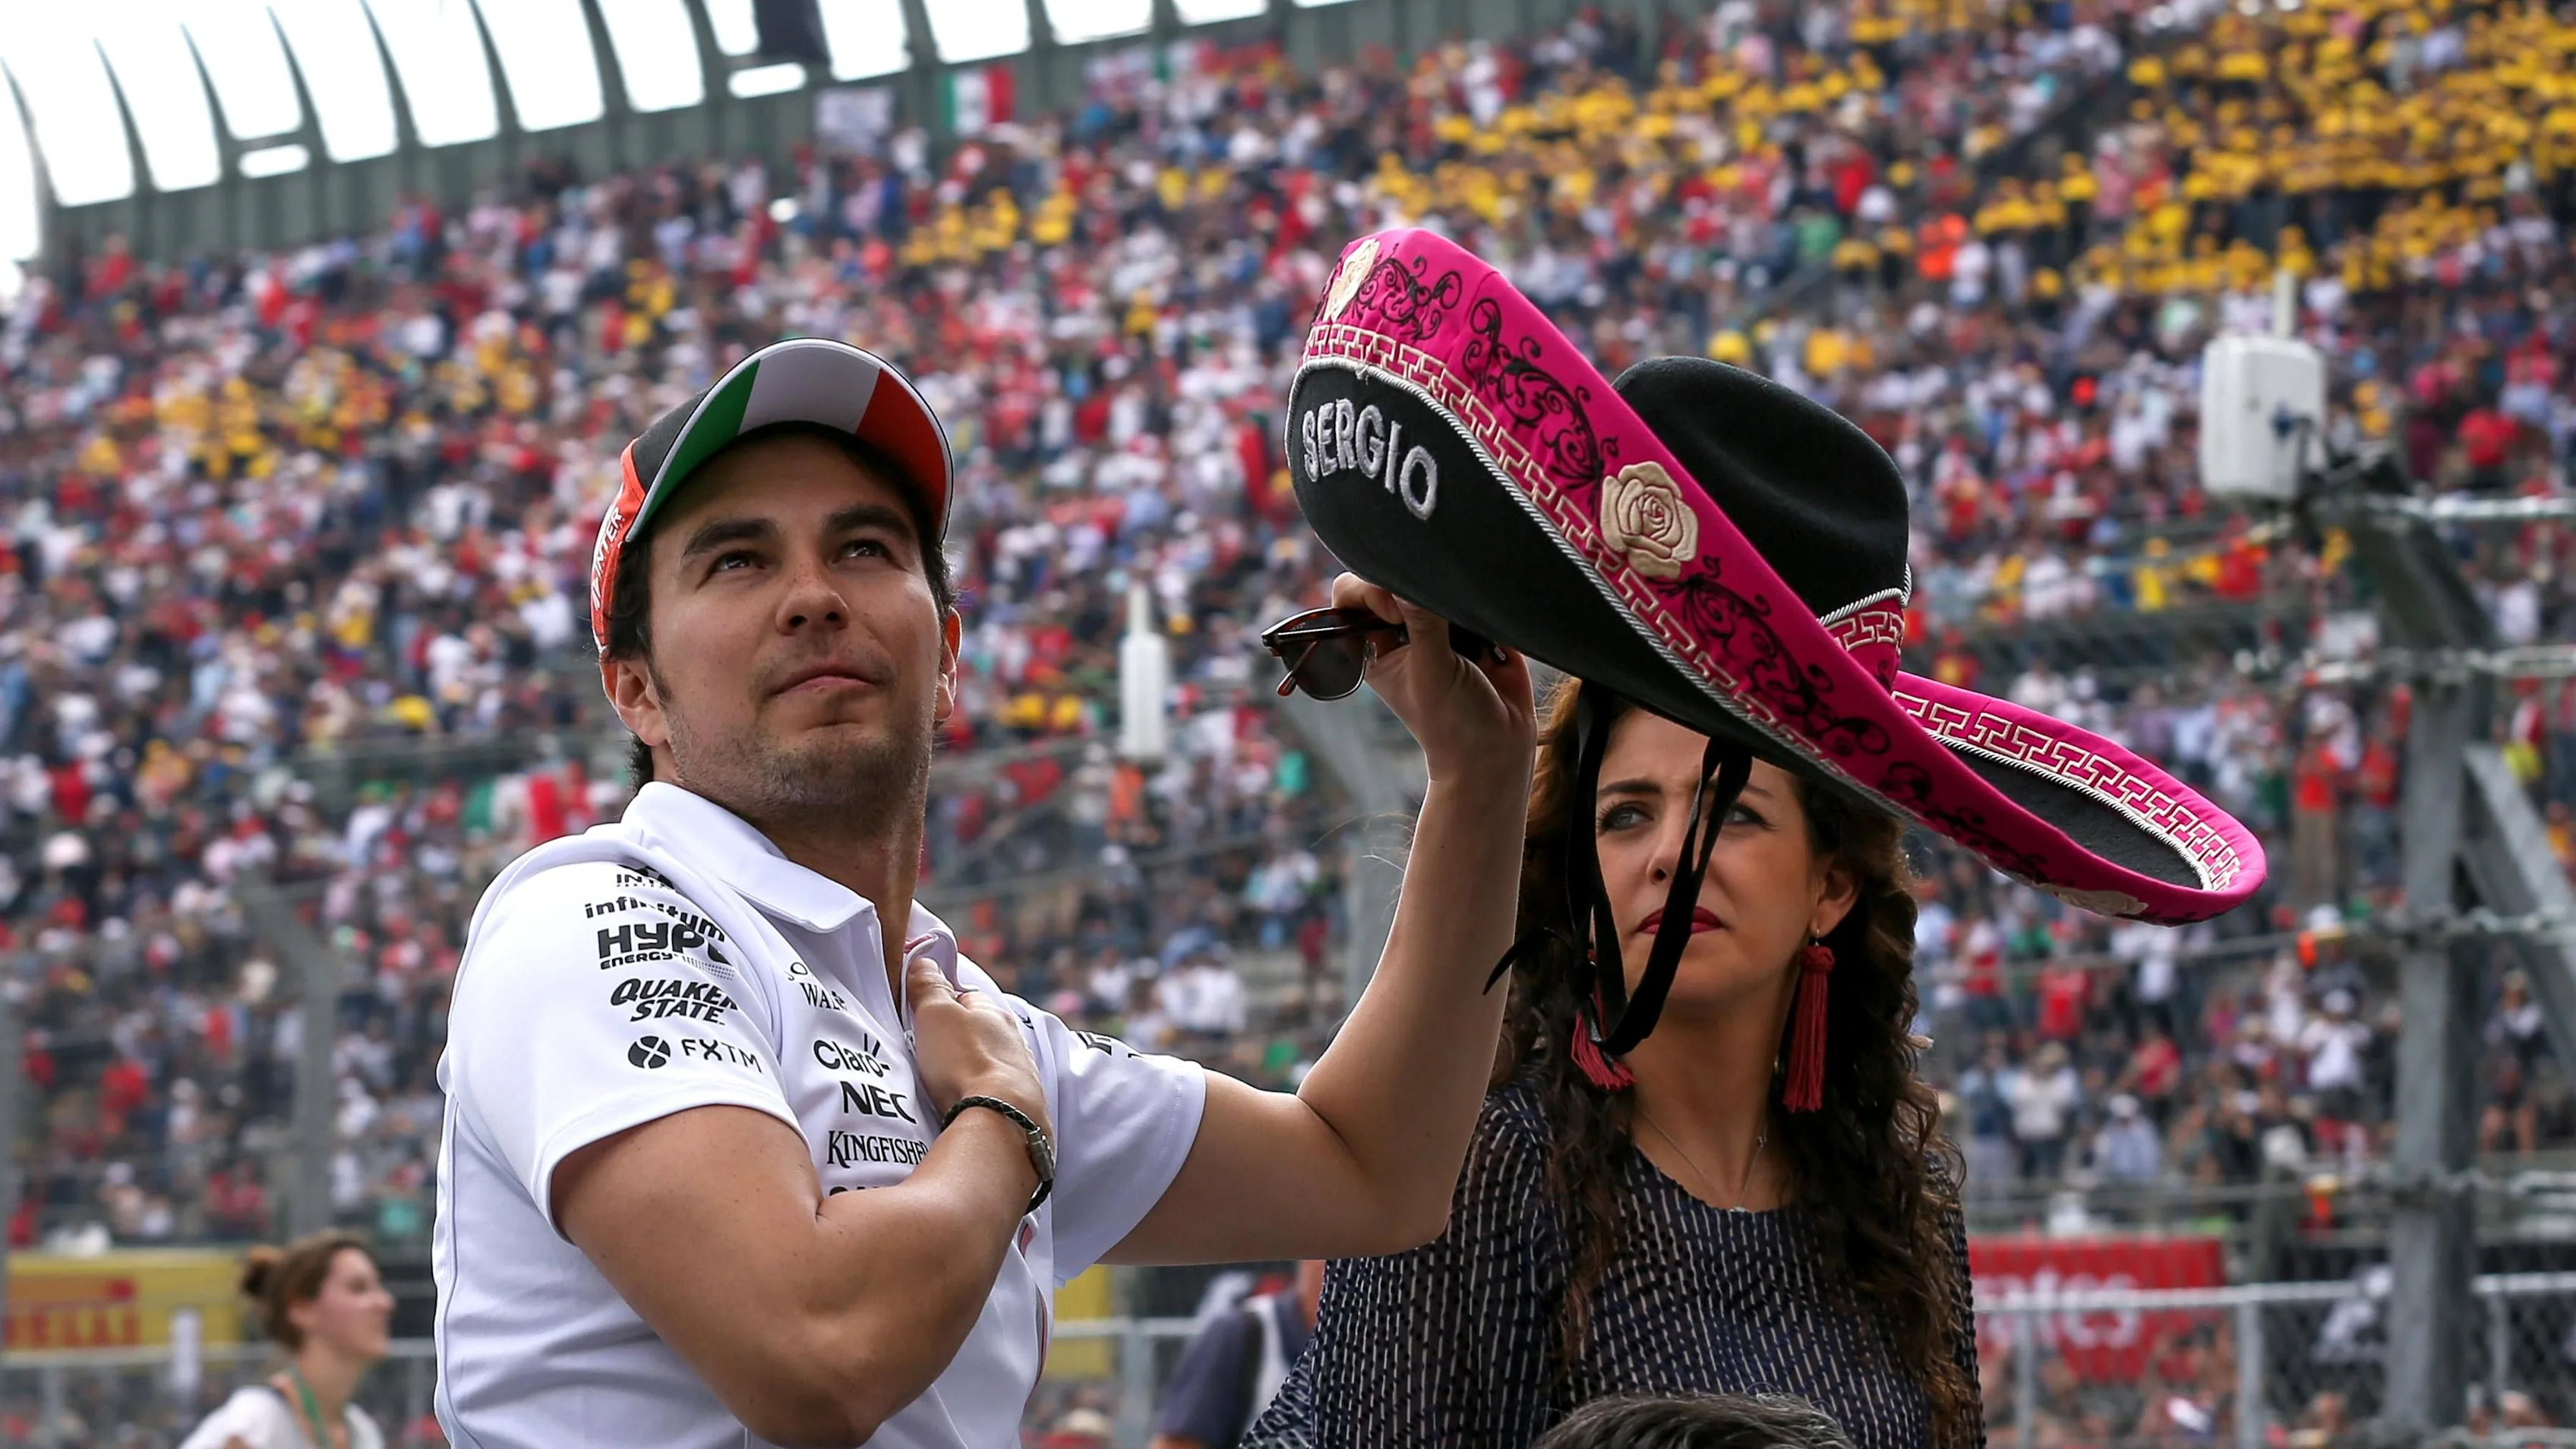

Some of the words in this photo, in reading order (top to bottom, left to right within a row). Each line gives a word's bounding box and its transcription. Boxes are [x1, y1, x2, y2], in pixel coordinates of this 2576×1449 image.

[1302, 398, 1438, 521] SERGIO
[585, 896, 724, 942] infitum
[601, 952, 673, 970] ENERGY
[630, 999, 724, 1024] STATE
[681, 1038, 762, 1073] FXTM
[813, 1036, 886, 1078] Claro
[840, 1080, 917, 1125] NEC
